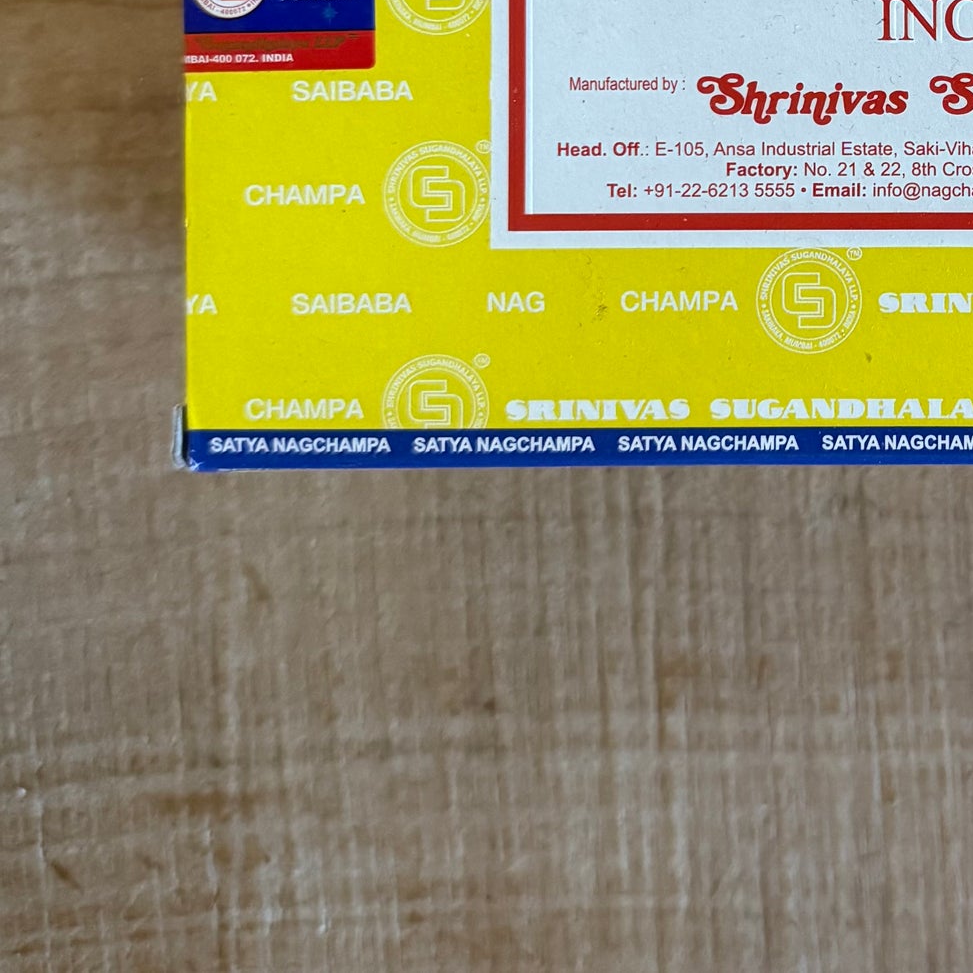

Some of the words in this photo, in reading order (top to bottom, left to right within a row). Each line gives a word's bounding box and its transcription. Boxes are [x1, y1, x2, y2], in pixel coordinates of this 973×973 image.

[235, 54, 259, 63] 072.
[262, 53, 294, 63] INDIA
[292, 81, 412, 101] SAIBABA
[569, 76, 658, 91] Manufactured
[662, 76, 679, 94] by
[696, 72, 909, 126] Shrinivas
[557, 141, 607, 157] Head.
[655, 141, 709, 159] E-105,
[713, 141, 756, 157] Ansa
[761, 141, 835, 157] Industrial
[841, 141, 897, 159] Estate,
[726, 161, 798, 181] Factory:
[804, 161, 832, 177] No.
[837, 161, 856, 177] 21
[863, 161, 876, 177] &
[880, 161, 905, 179] 22,
[911, 161, 937, 177] 8th
[244, 185, 365, 206] CHAMPA
[606, 183, 637, 198] Tel:
[643, 182, 749, 198] +91-22-6213
[754, 182, 796, 198] 5555
[812, 182, 866, 198] Email:
[292, 293, 411, 315] SAIBABA
[488, 292, 544, 313] NAG
[621, 291, 738, 312] CHAMPA
[245, 399, 363, 420] CHAMPA
[505, 399, 690, 421] SRINIVAS
[211, 438, 268, 452] SATYA
[274, 438, 390, 452] NAGCHAMPA
[415, 437, 472, 452] SATYA
[478, 437, 594, 451] NAGCHAMPA
[619, 436, 676, 451] SATYA
[682, 436, 798, 450] NAGCHAMPA
[823, 435, 879, 450] SATYA
